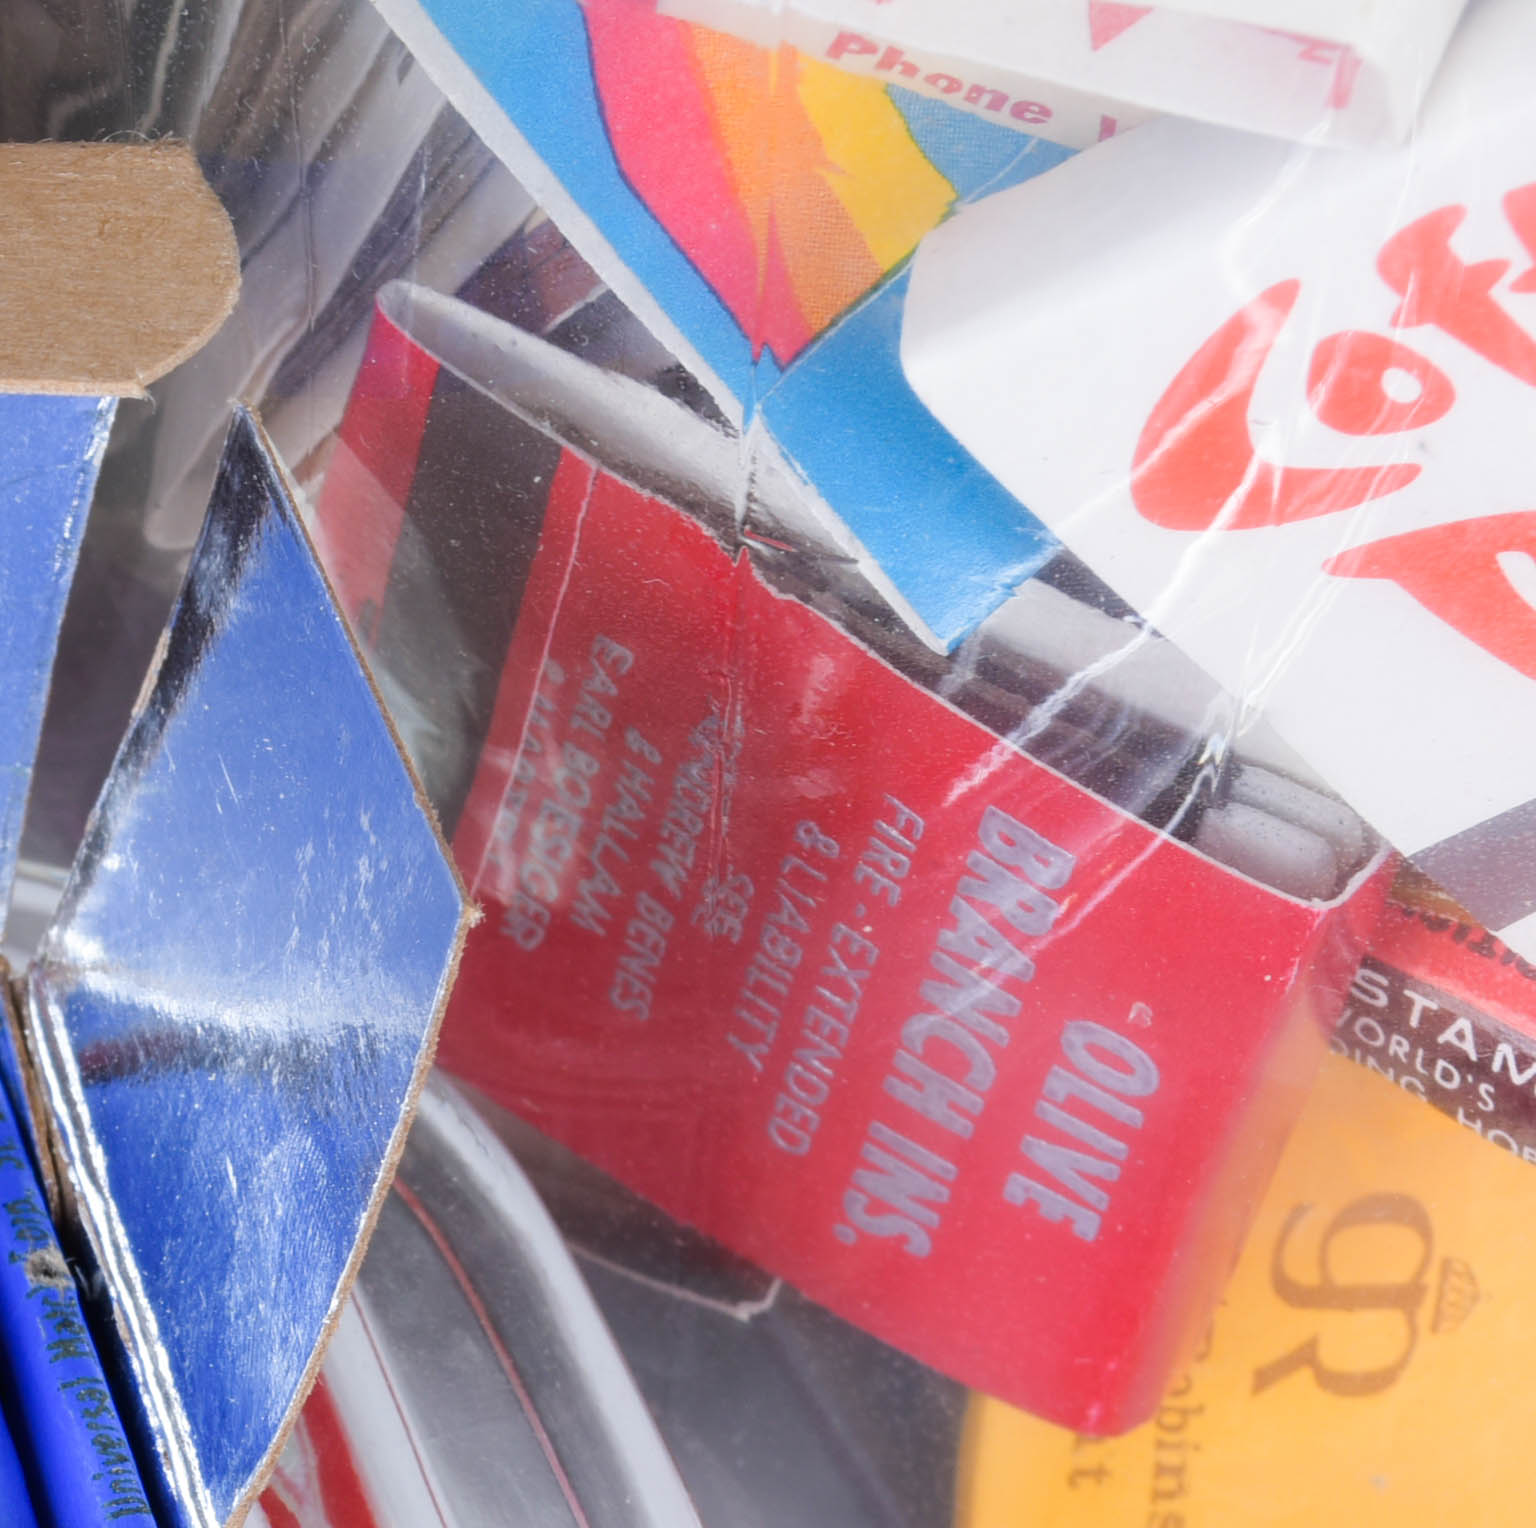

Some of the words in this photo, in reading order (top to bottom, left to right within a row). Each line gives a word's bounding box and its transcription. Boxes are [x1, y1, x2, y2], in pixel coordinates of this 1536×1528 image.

[824, 30, 1053, 126] Phone
[570, 633, 634, 741] EARL
[570, 760, 655, 936] HALLAM
[794, 820, 839, 858] &
[854, 791, 925, 907] FIRE
[609, 891, 675, 1021] BENES
[728, 855, 828, 1073] LIABILITY
[884, 805, 1076, 1139] BRANCH
[767, 922, 879, 1156] EXTENDED
[1336, 1006, 1495, 1113] ORLD'S
[833, 1121, 959, 1258] INS.
[1003, 1019, 1160, 1243] OLIVE
